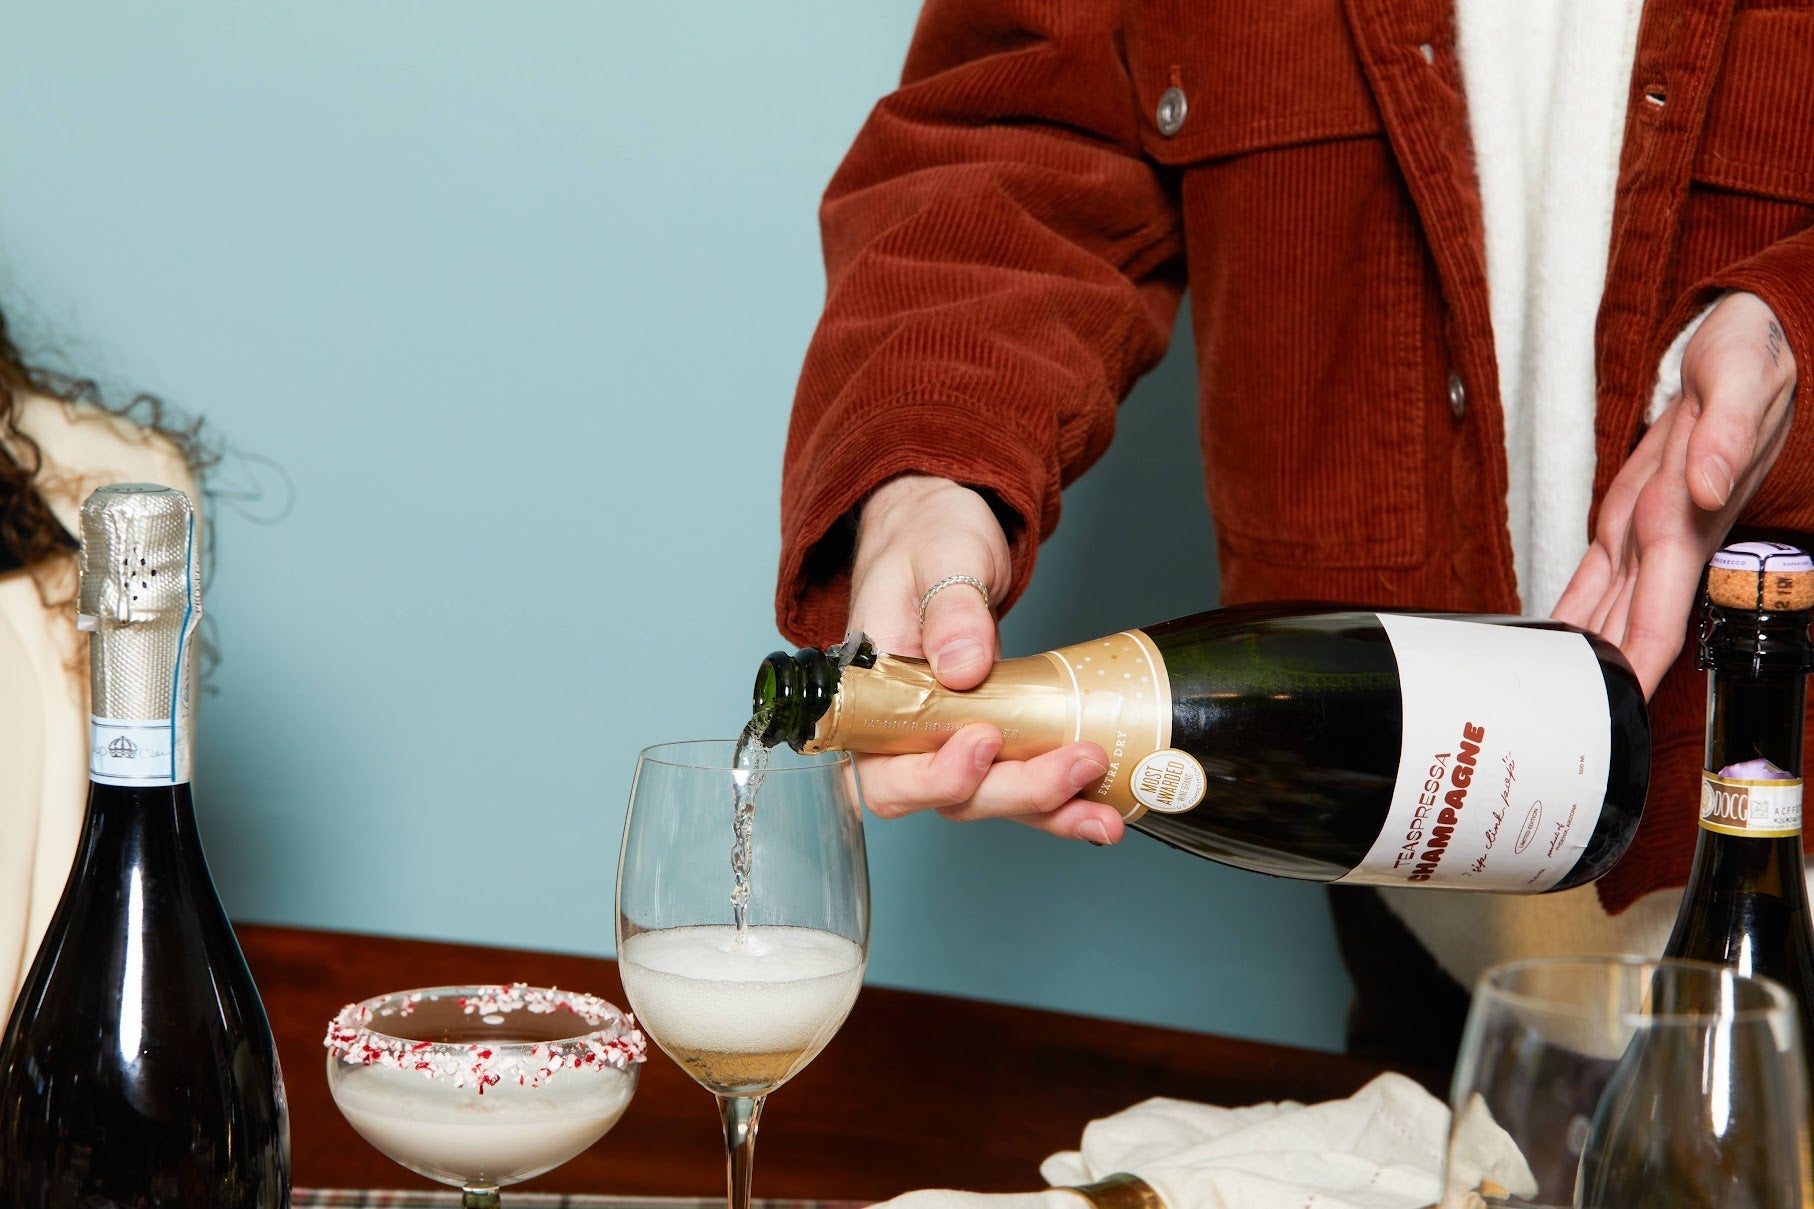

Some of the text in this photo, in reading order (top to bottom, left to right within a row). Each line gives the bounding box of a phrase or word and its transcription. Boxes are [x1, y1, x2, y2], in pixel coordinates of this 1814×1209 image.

[1097, 730, 1127, 795] EXTRA DRY
[1140, 766, 1163, 794] MOST
[1156, 760, 1185, 805] AWARDED
[1393, 753, 1451, 869] TEASPRESSA
[1407, 721, 1485, 883] CHAMPAGNE
[1714, 791, 1748, 821] DOCG
[1518, 808, 1539, 849] LIMITED EDITION
